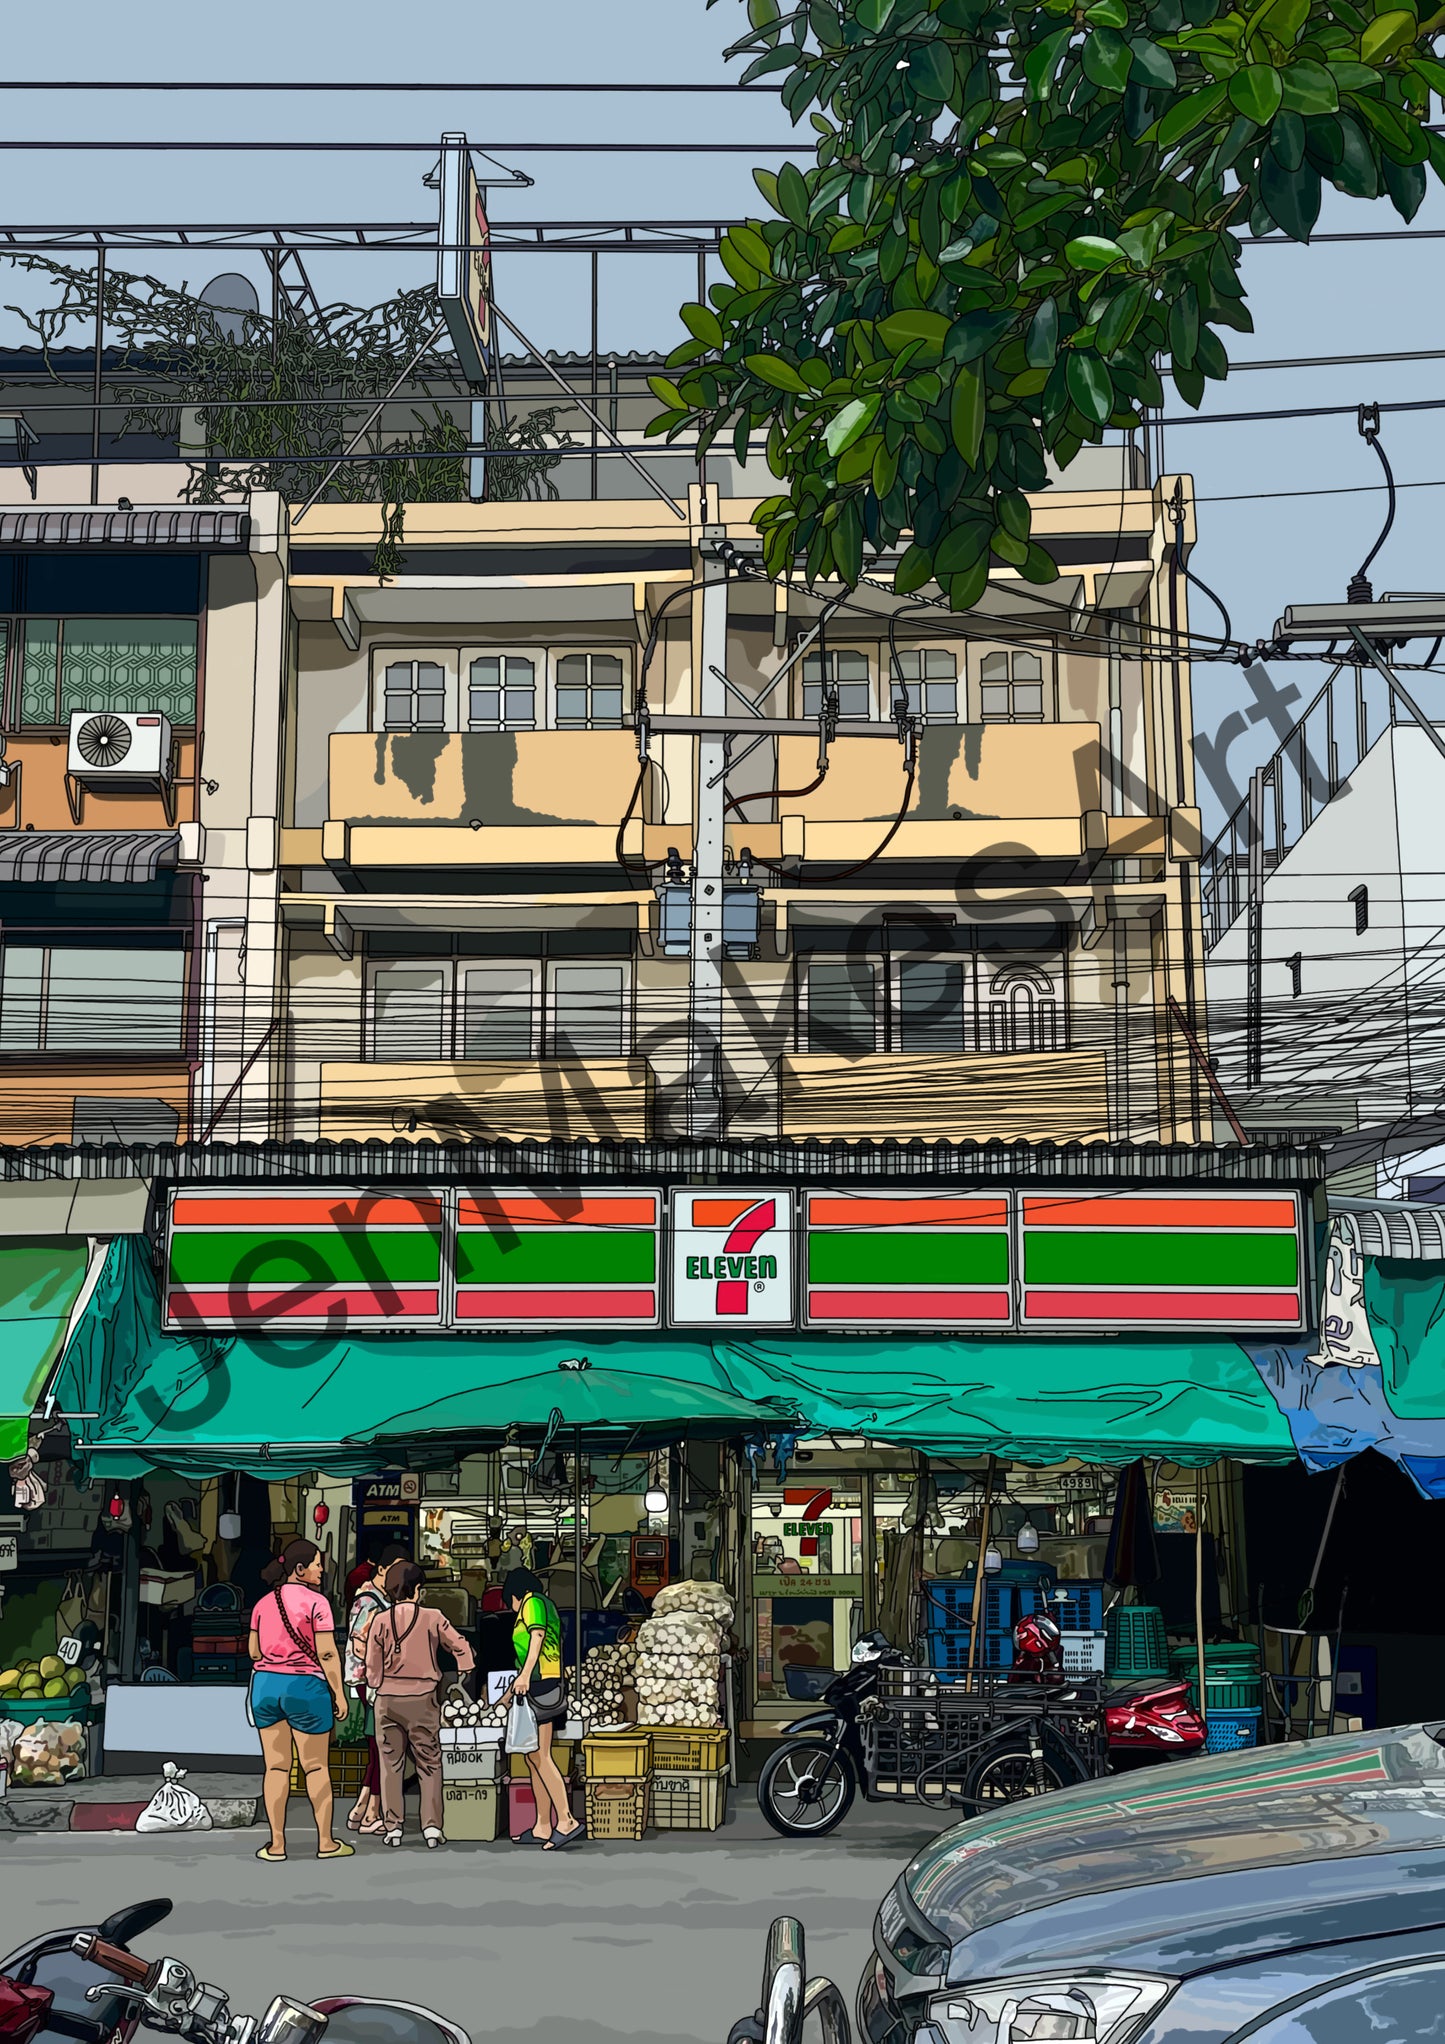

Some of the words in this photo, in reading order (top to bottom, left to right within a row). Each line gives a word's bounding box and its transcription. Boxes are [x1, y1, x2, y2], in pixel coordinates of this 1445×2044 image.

[1062, 1478, 1091, 1488] 4989
[366, 1484, 400, 1496] ATM
[59, 1641, 78, 1660] 40
